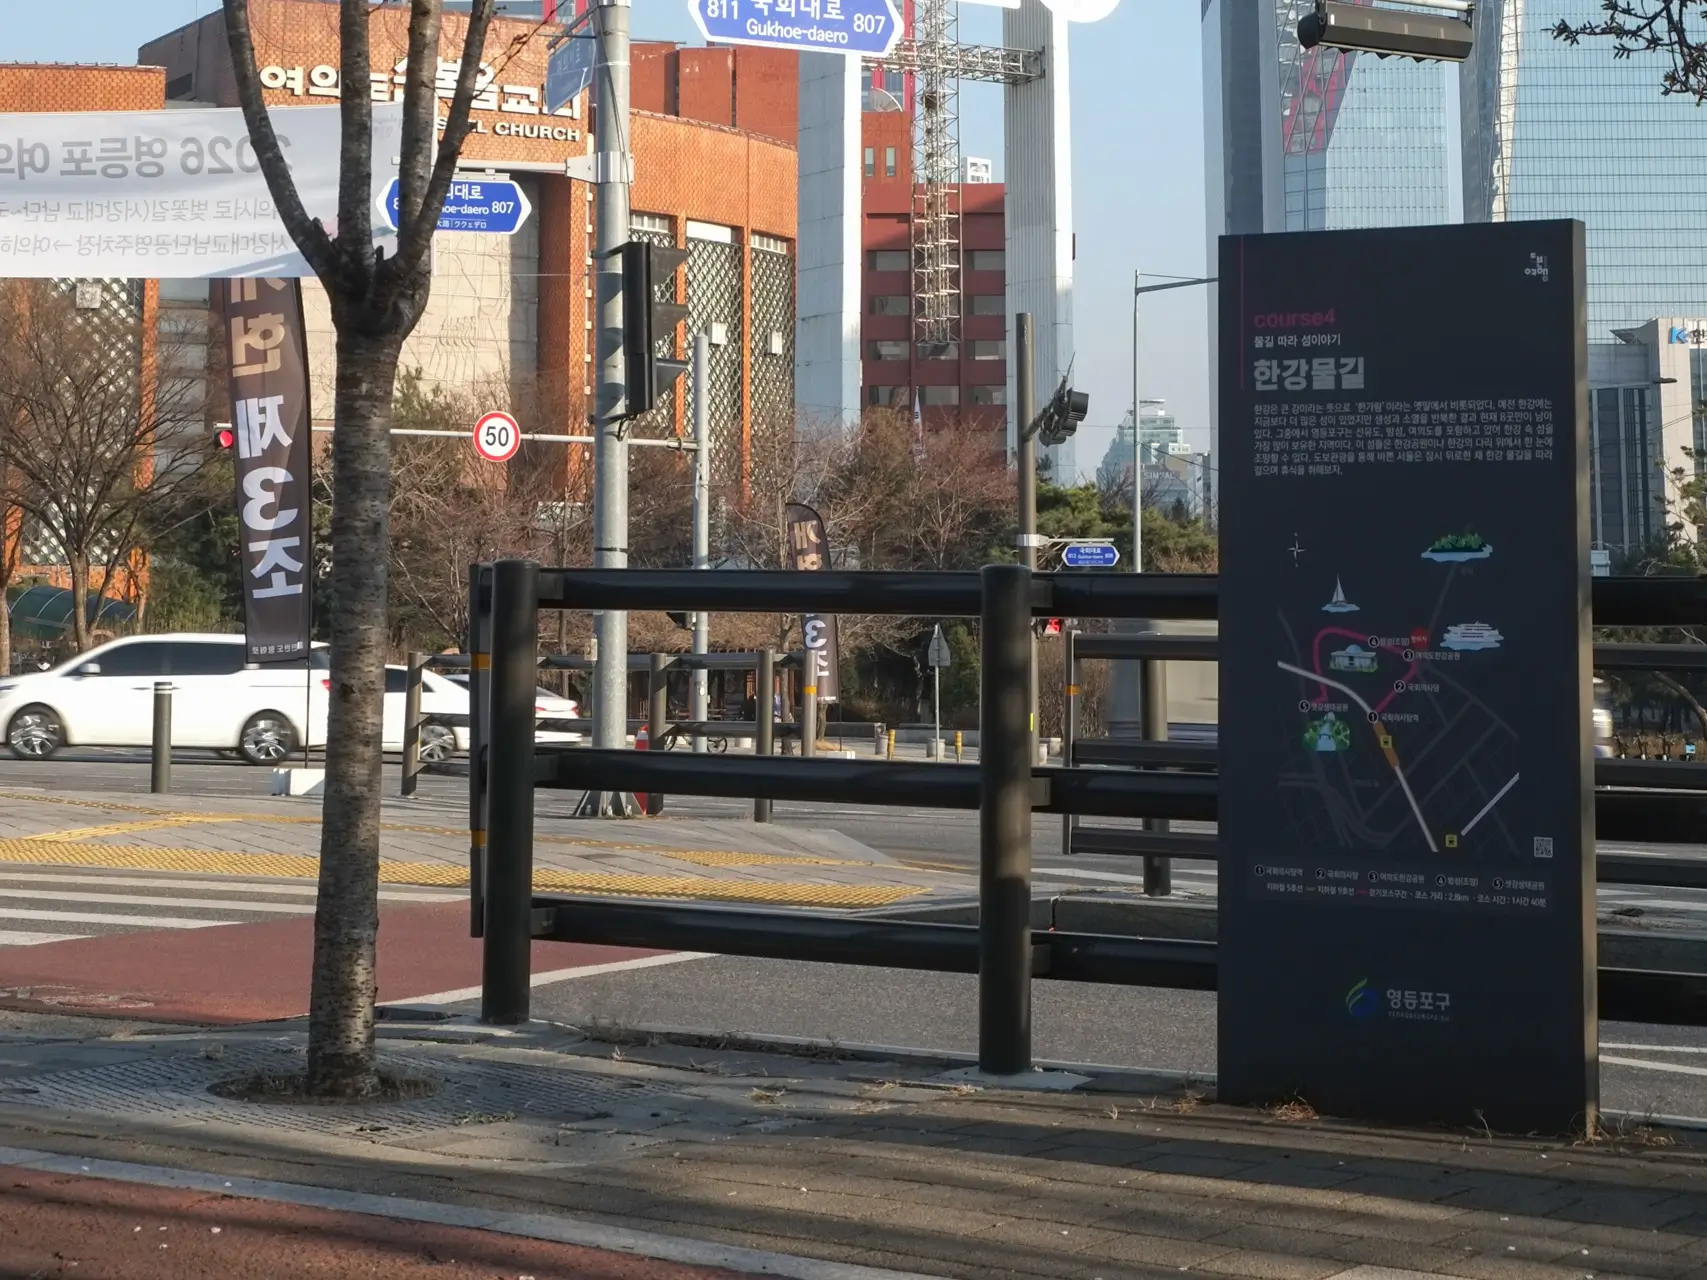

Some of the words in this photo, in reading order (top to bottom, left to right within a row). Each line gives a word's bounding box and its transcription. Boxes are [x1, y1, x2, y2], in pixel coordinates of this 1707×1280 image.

[746, 18, 848, 44] Gukhoe-daero
[853, 13, 885, 35] 807
[495, 122, 580, 141] CHURCH
[492, 201, 514, 214] 807
[1254, 307, 1337, 328] course4
[1253, 335, 1274, 348] 물길
[1277, 334, 1298, 347] 따라
[1301, 333, 1341, 347] 섬이야기
[1254, 356, 1365, 391] 한강물길
[1254, 403, 1277, 414] 한강은
[1292, 403, 1324, 413] 강이라는
[1326, 402, 1351, 413] 뜻으로
[1519, 399, 1552, 409] 한강에는
[1254, 416, 1286, 427] 지금보다
[1300, 416, 1317, 426] 많은
[1319, 415, 1335, 426] 섬이
[1504, 424, 1521, 435] 한강
[485, 426, 509, 447] 50
[1254, 441, 1270, 452] 가장
[1292, 441, 1316, 451] 보유한
[1448, 438, 1472, 449] 한강의
[1476, 438, 1492, 449] 다리
[1486, 450, 1503, 461] 한강
[1536, 450, 1552, 461] 따라
[1386, 988, 1451, 1012] 영등포구
